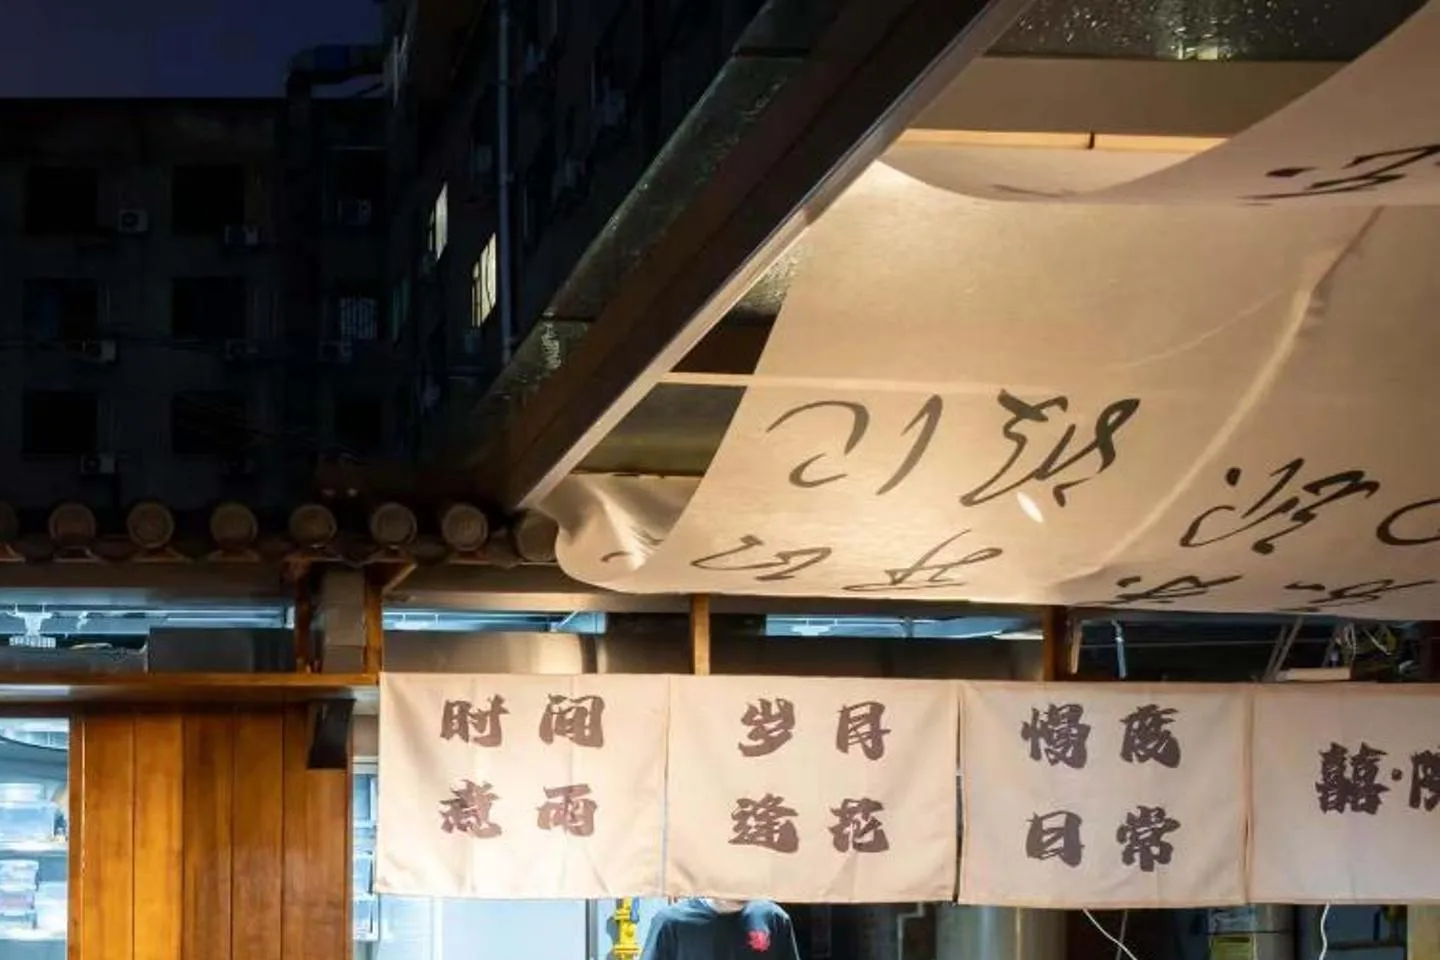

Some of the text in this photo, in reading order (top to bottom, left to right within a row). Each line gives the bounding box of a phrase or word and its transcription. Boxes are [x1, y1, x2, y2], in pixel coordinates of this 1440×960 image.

[439, 693, 606, 749] 时间
[738, 697, 892, 762] 岁月
[438, 778, 598, 839] 煮雨
[1025, 804, 1181, 872] 日常
